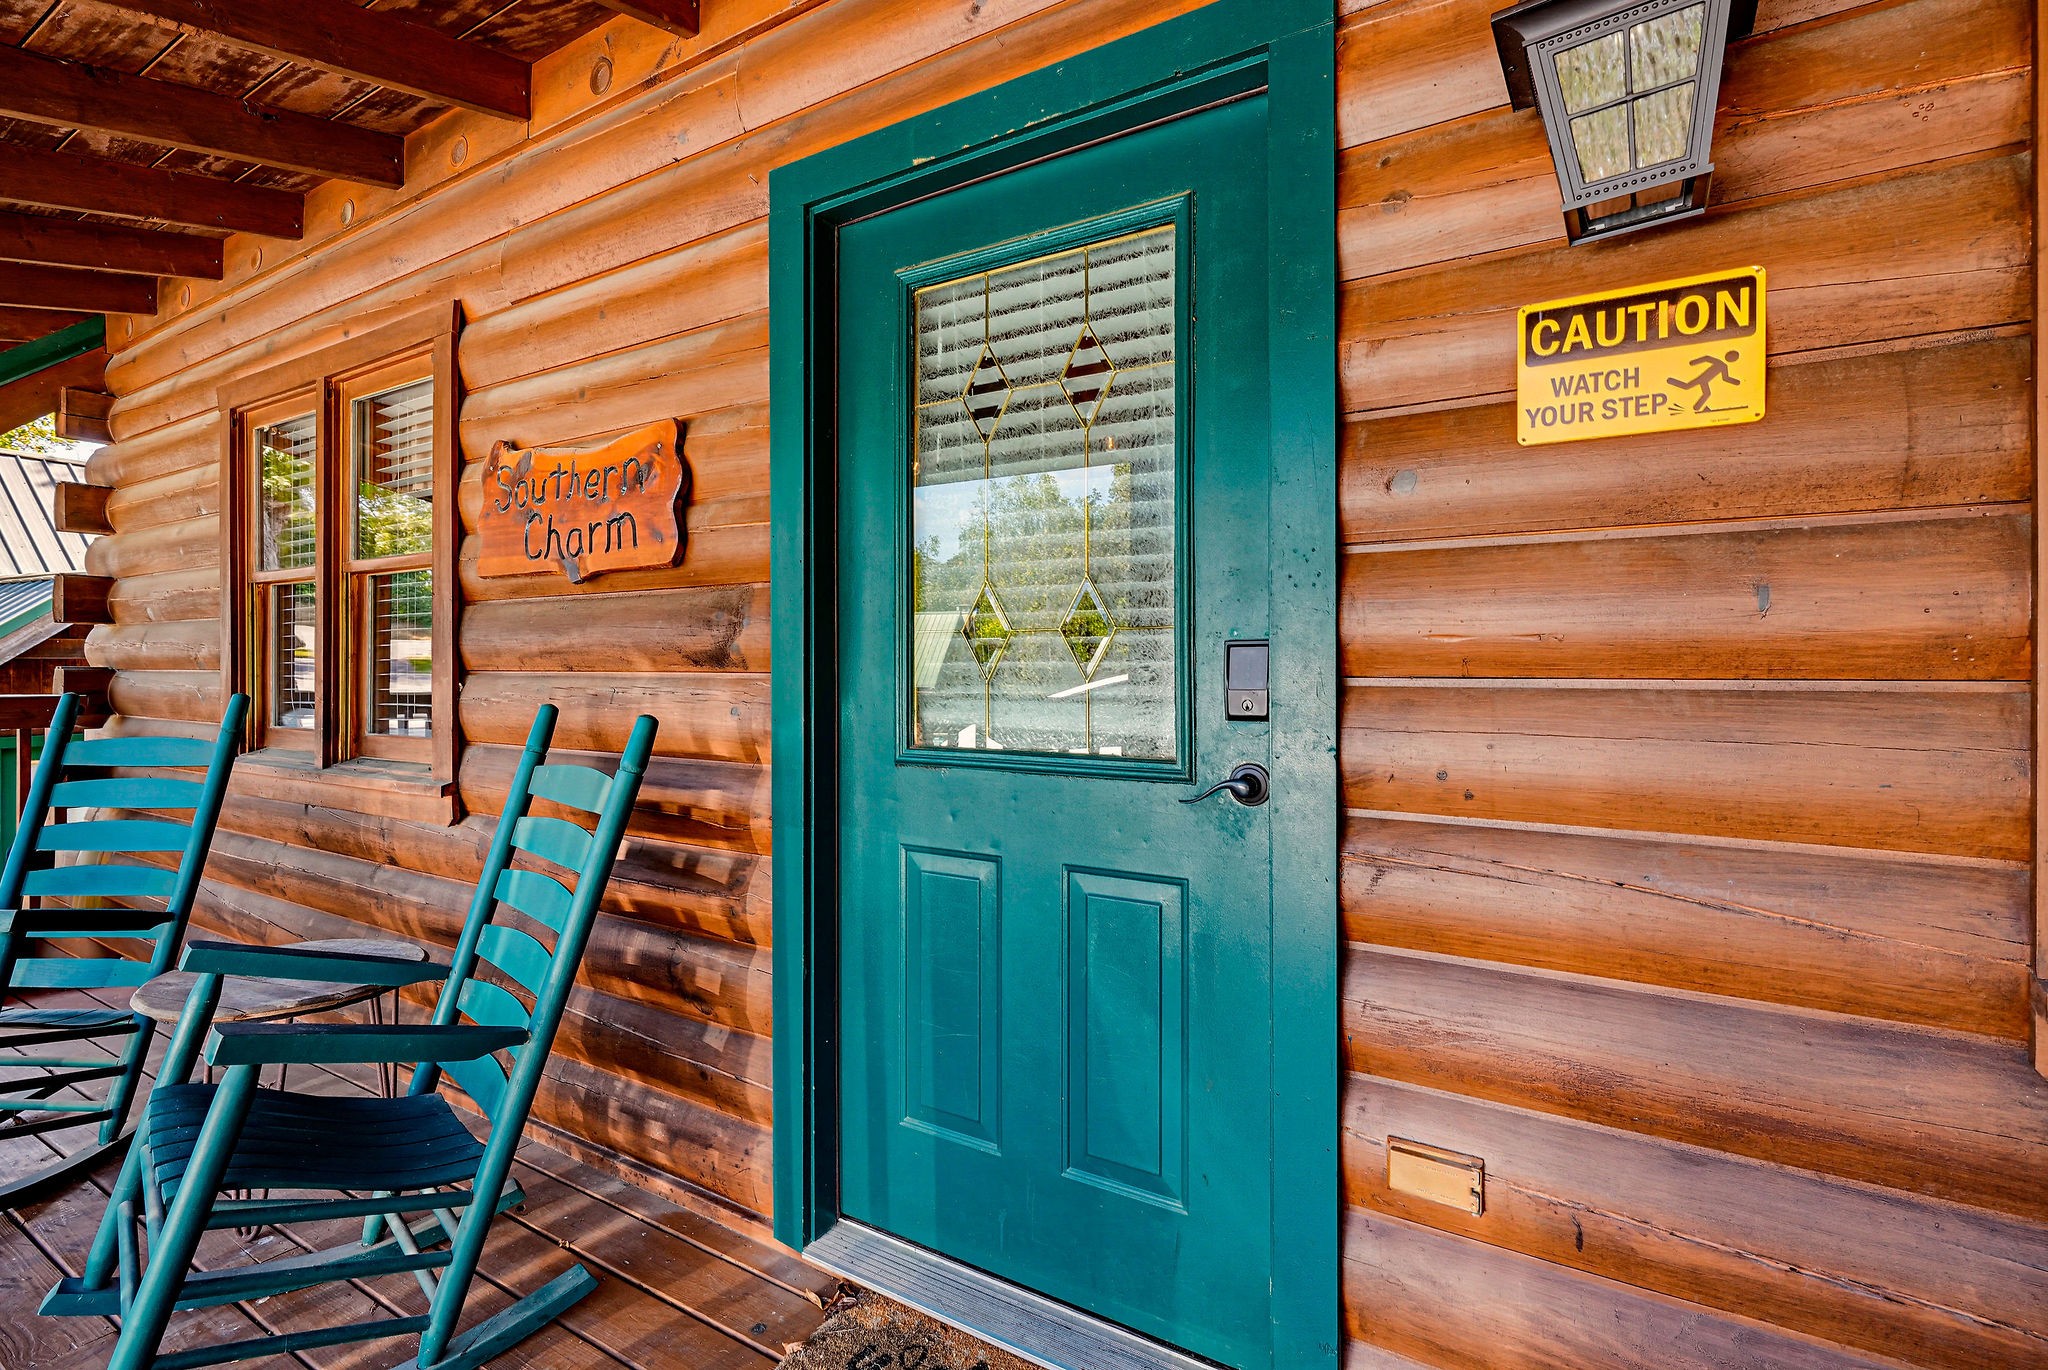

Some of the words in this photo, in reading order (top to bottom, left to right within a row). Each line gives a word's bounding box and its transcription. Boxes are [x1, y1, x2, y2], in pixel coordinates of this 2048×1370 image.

[1530, 286, 1750, 358] CAUTION
[1550, 366, 1640, 398] WATCH
[1525, 402, 1594, 429] YOUR
[1601, 392, 1668, 421] STEP
[495, 456, 646, 513] Southern
[524, 511, 638, 561] Charm
